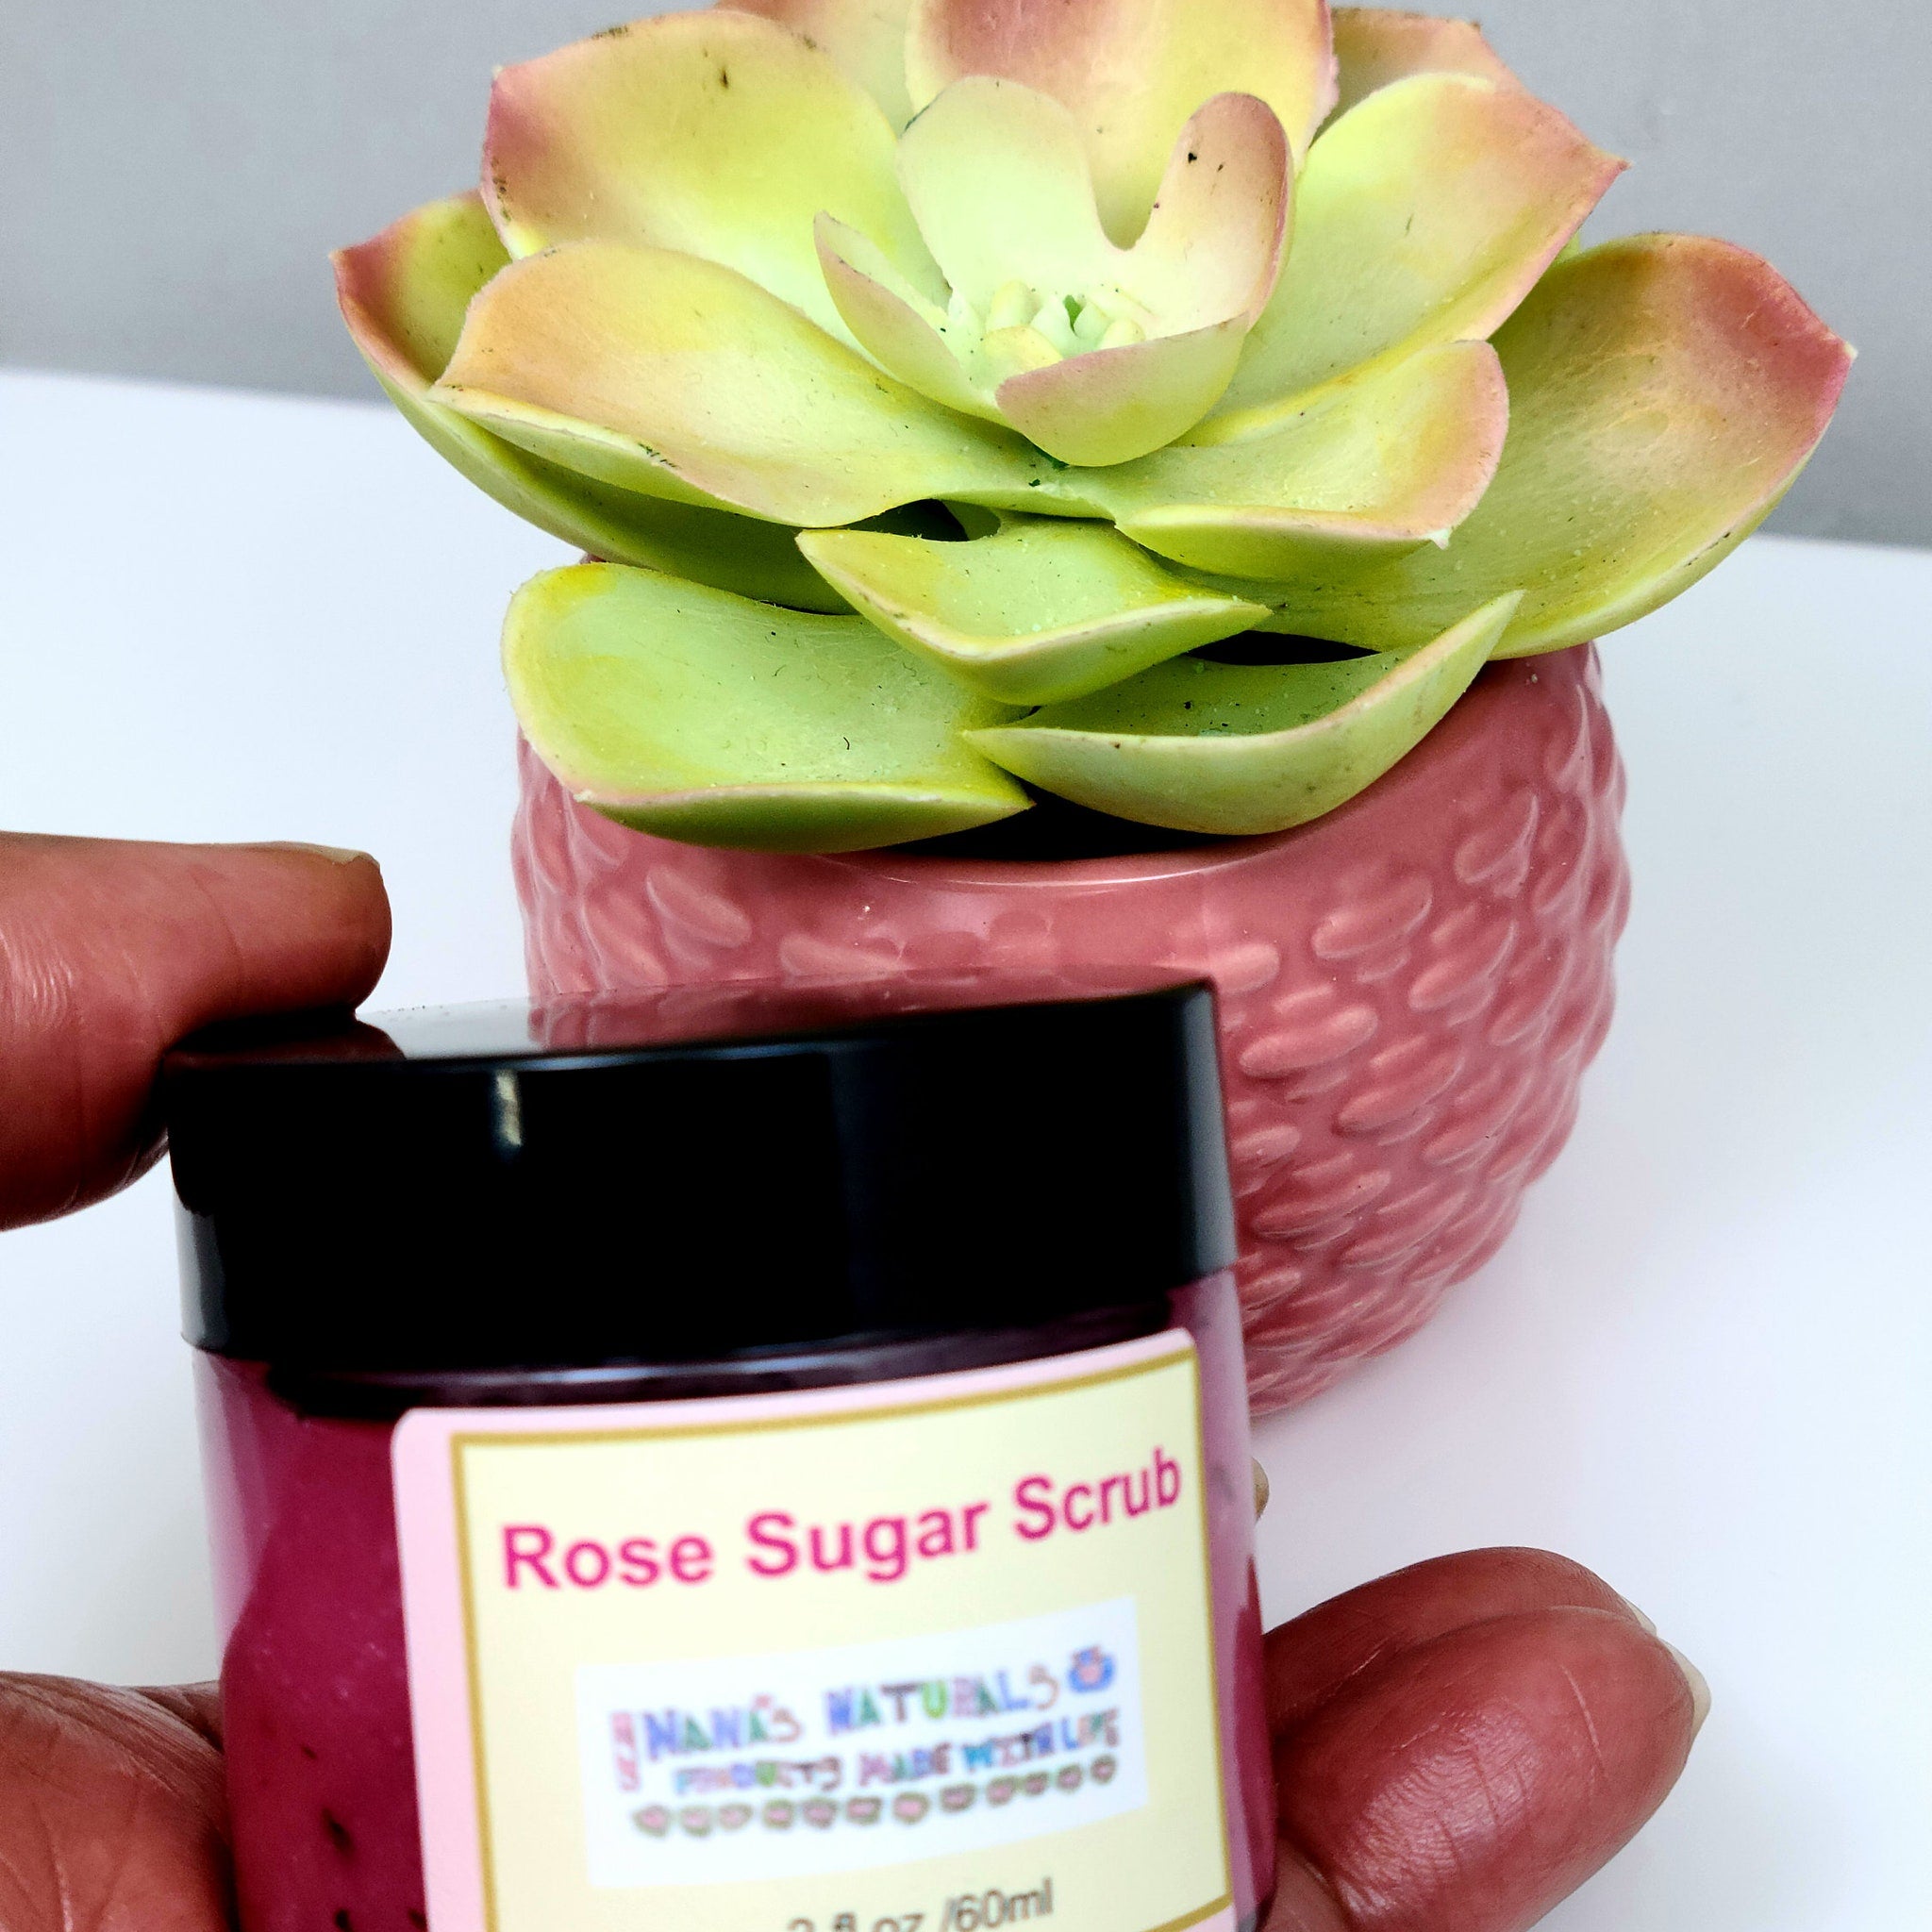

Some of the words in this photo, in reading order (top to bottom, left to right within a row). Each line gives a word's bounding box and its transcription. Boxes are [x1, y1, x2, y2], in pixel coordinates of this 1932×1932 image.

[502, 1523, 714, 1590] Rose
[745, 1502, 990, 1583] Sugar
[1013, 1446, 1182, 1541] Scrub
[825, 1663, 1060, 1736] NATURALS
[858, 1742, 952, 1787] MADE
